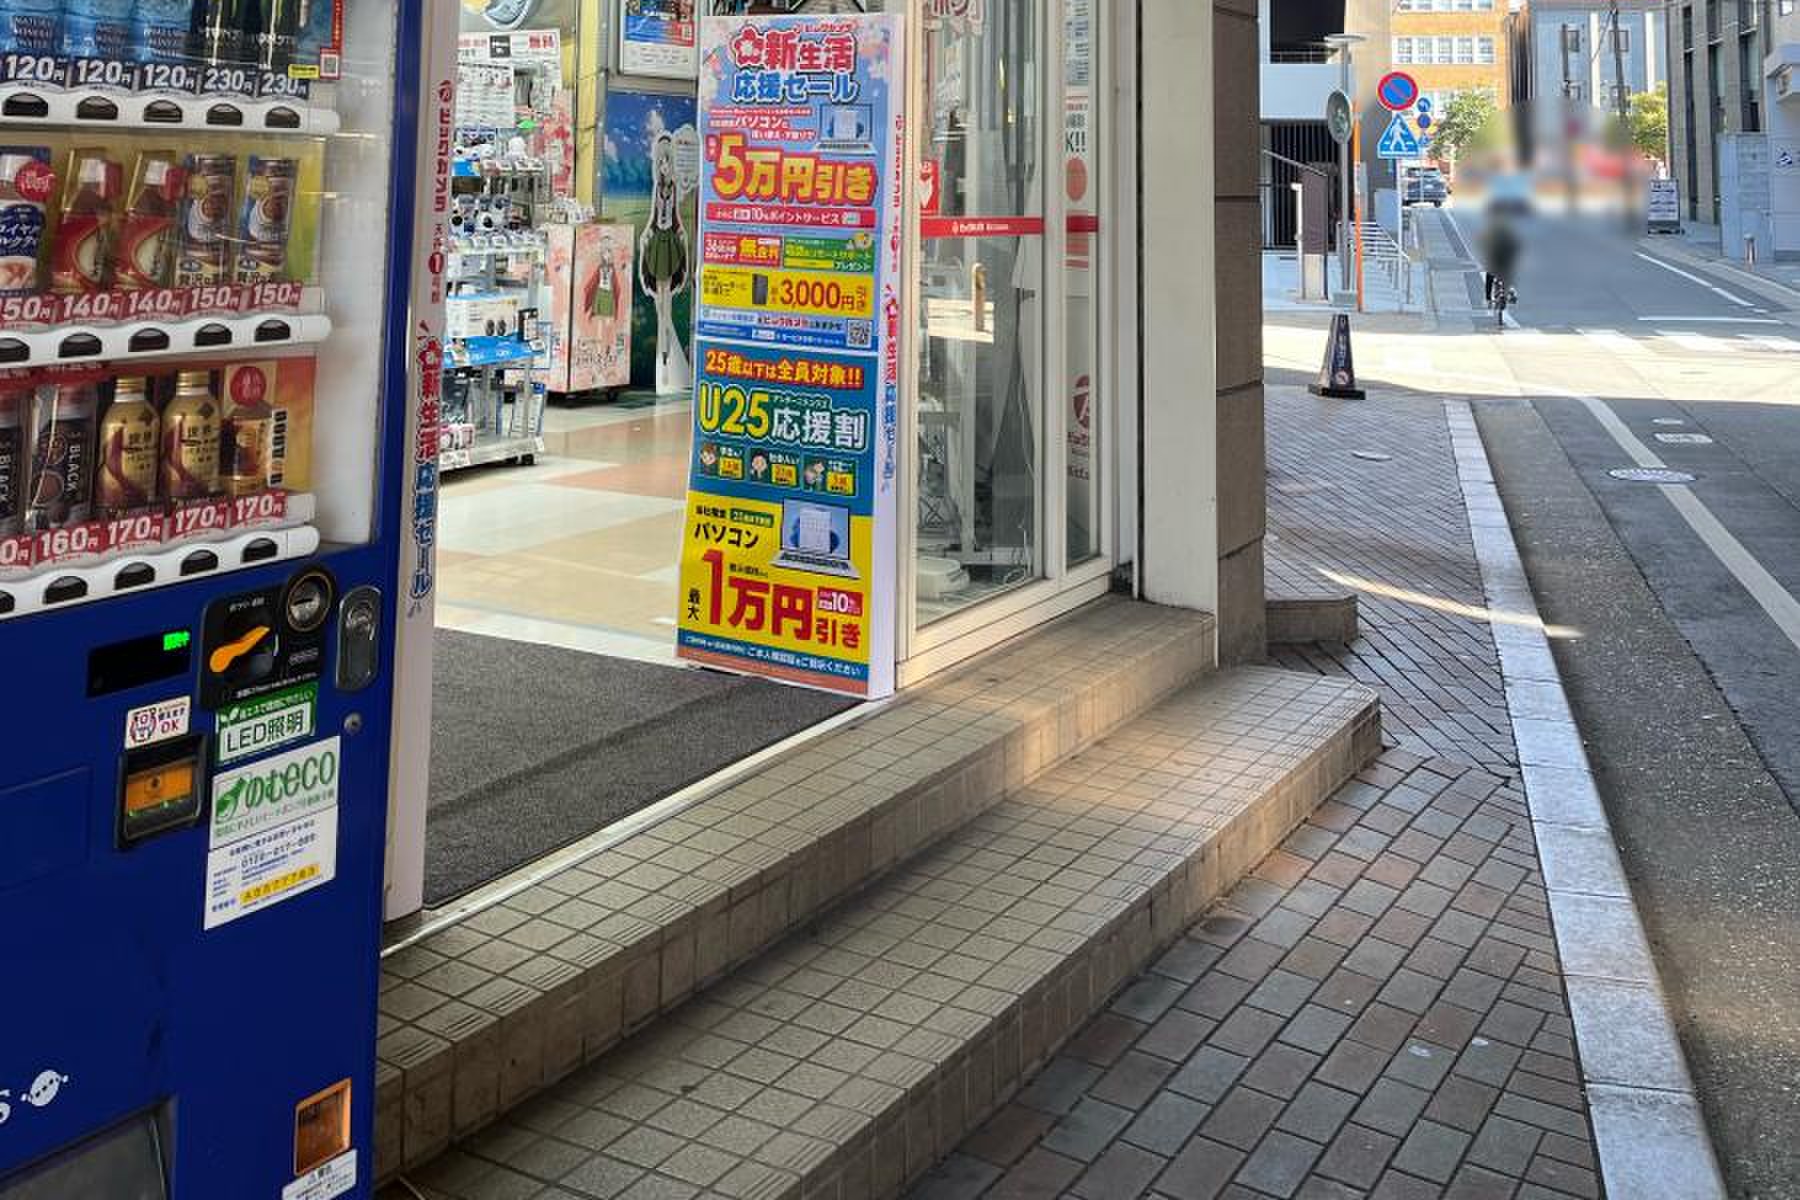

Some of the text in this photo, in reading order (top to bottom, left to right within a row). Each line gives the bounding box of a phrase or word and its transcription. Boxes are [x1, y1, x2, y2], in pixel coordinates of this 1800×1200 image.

[763, 31, 855, 71] 新生活
[5, 56, 65, 80] 120円
[77, 60, 132, 84] 120円
[144, 64, 195, 88] 120円
[204, 68, 251, 92] 230円
[734, 71, 857, 102] 応援セール
[713, 133, 875, 202] 5万円引き
[63, 294, 120, 317] 140円
[129, 290, 181, 314] 140円
[191, 287, 240, 309] 150円
[254, 284, 300, 306] 150円
[779, 279, 857, 312] 3,000円
[705, 350, 864, 387] 25歳以下は全員対象!!
[65, 443, 82, 495] BLACK
[175, 505, 224, 530] 170円
[236, 496, 282, 520] 170円
[40, 527, 99, 557] 160円
[108, 519, 161, 546] 170円
[694, 523, 759, 549] パソコン
[687, 548, 861, 650] 最大 1万円引き
[160, 718, 181, 734] OK
[226, 708, 305, 753] LED照明
